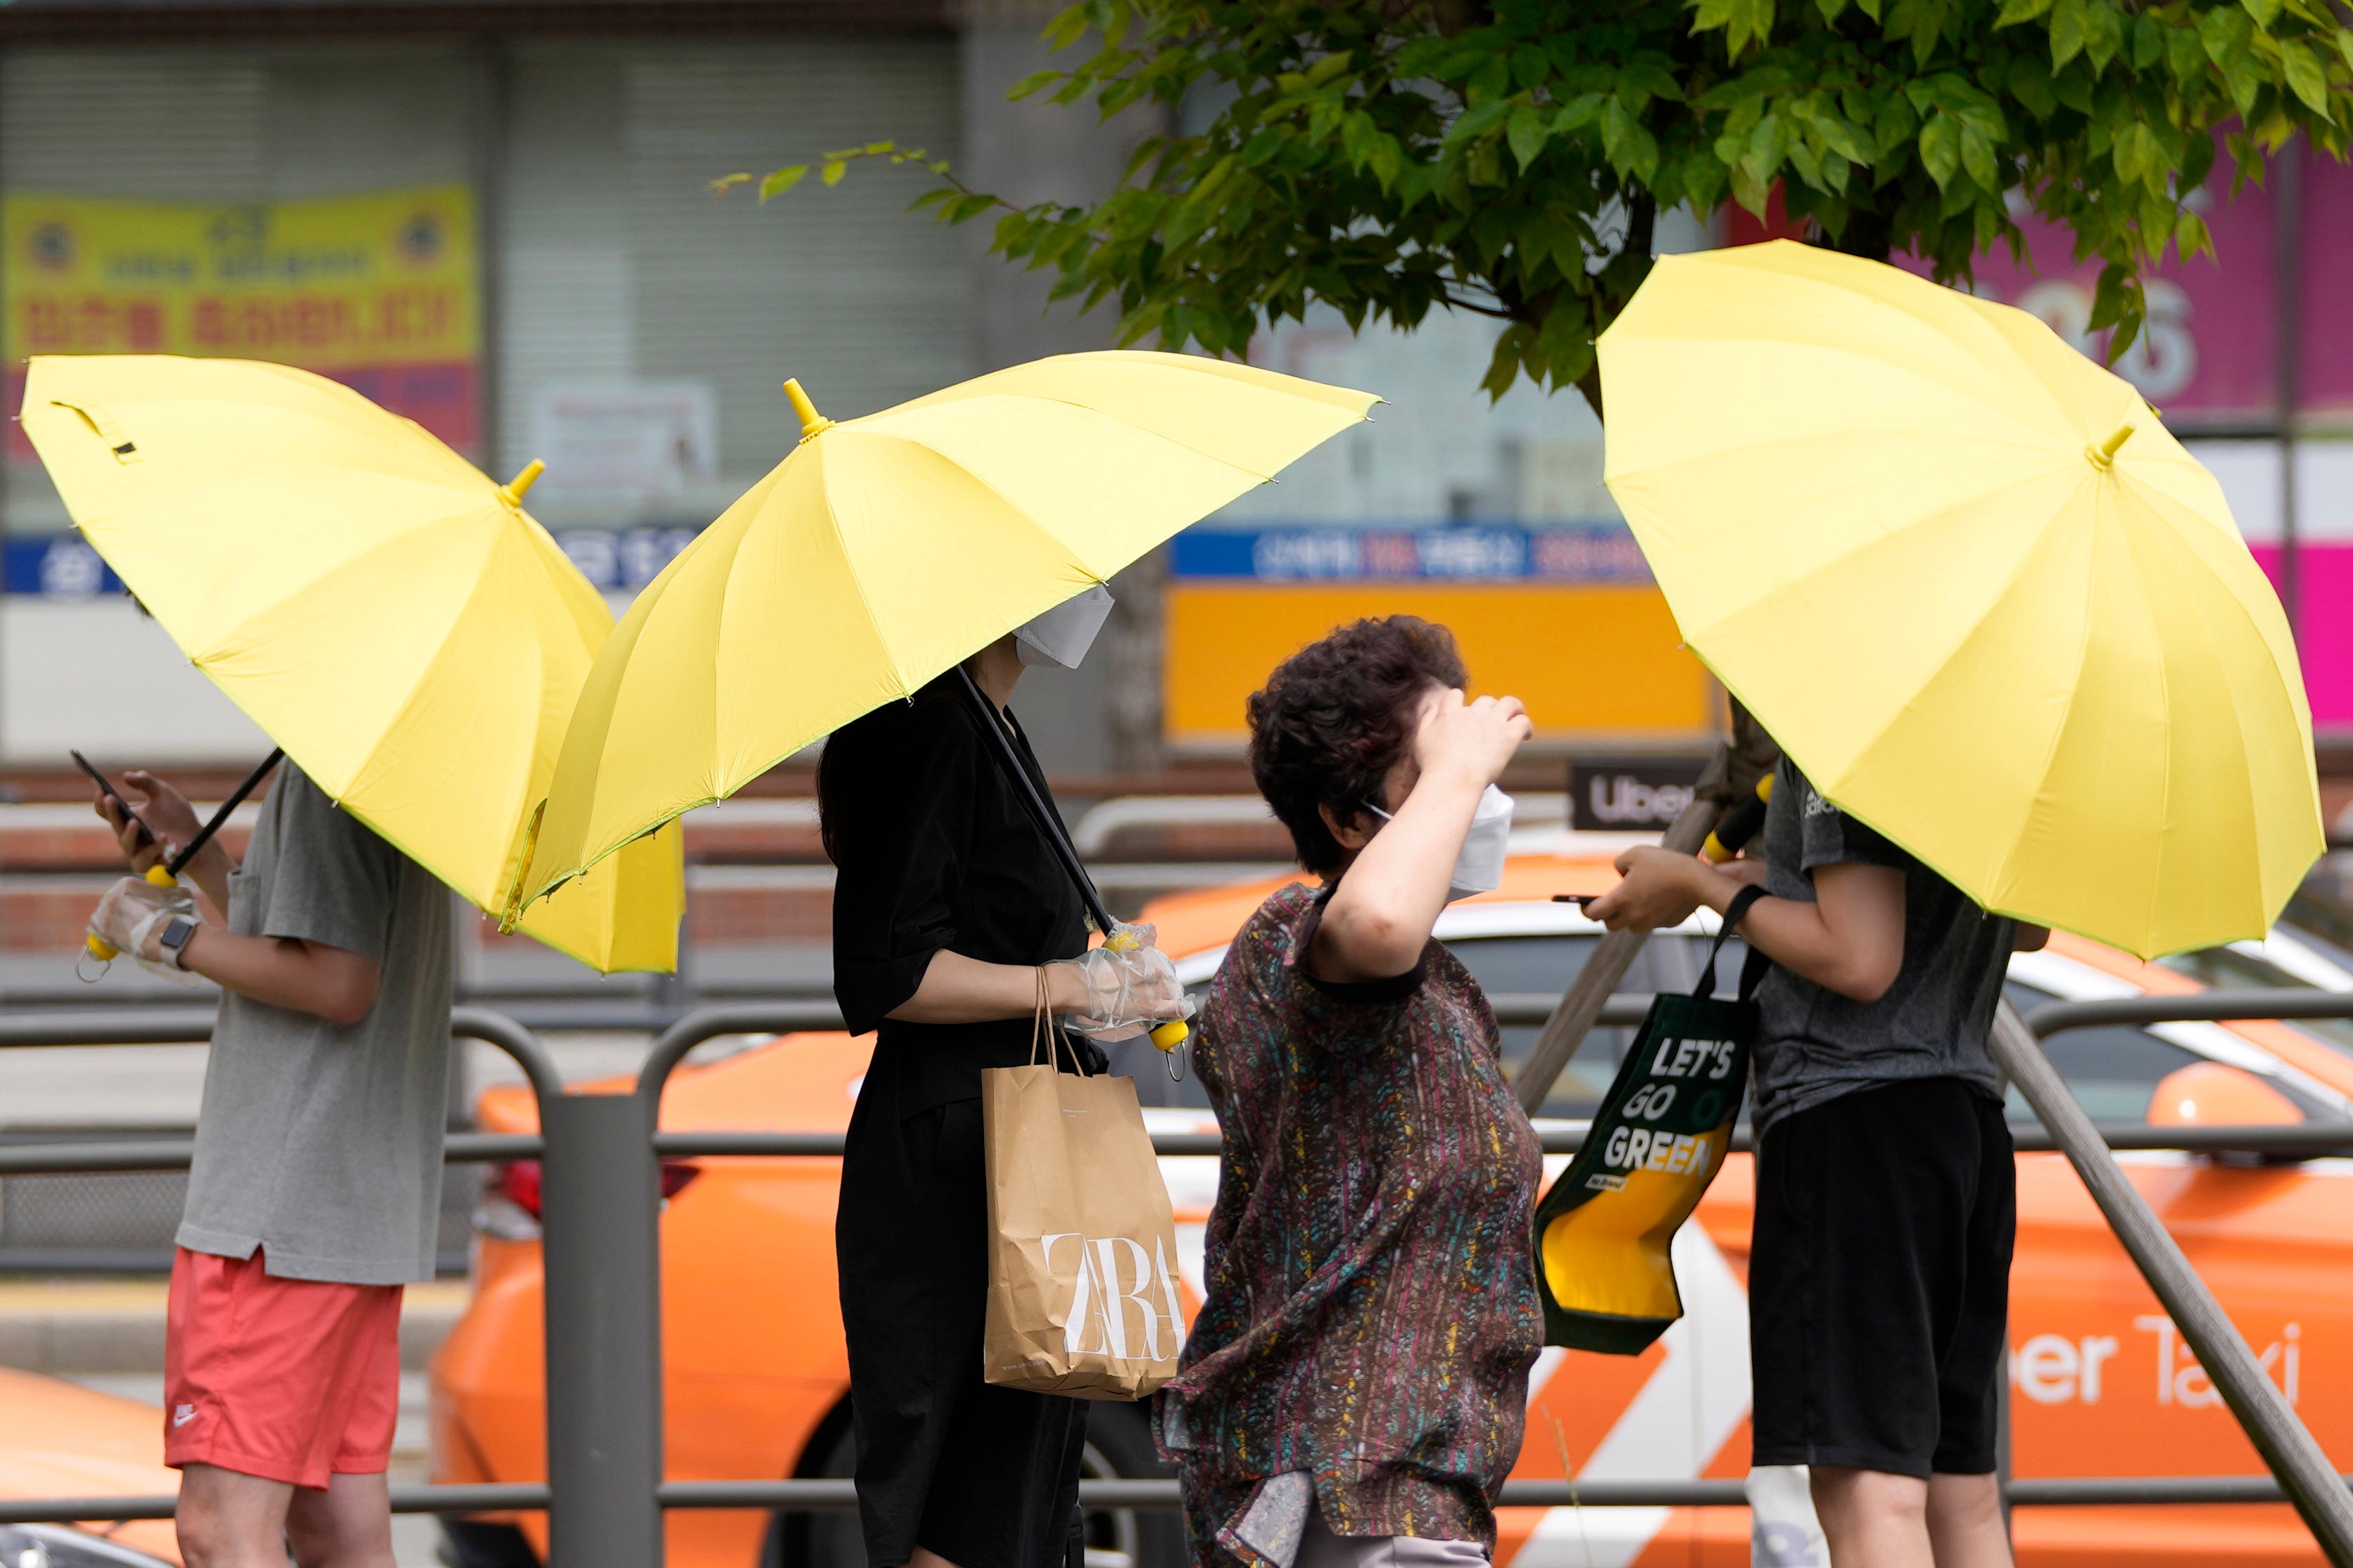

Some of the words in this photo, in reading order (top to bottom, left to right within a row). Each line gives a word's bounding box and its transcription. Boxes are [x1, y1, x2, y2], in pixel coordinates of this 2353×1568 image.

[1650, 1037, 1736, 1080] LET'S
[1622, 1083, 1677, 1120] GO
[1603, 1125, 1713, 1177] GREEN
[1041, 1232, 1186, 1362] ZARA
[2007, 1333, 2118, 1405] er
[2132, 1314, 2301, 1410] Tai
